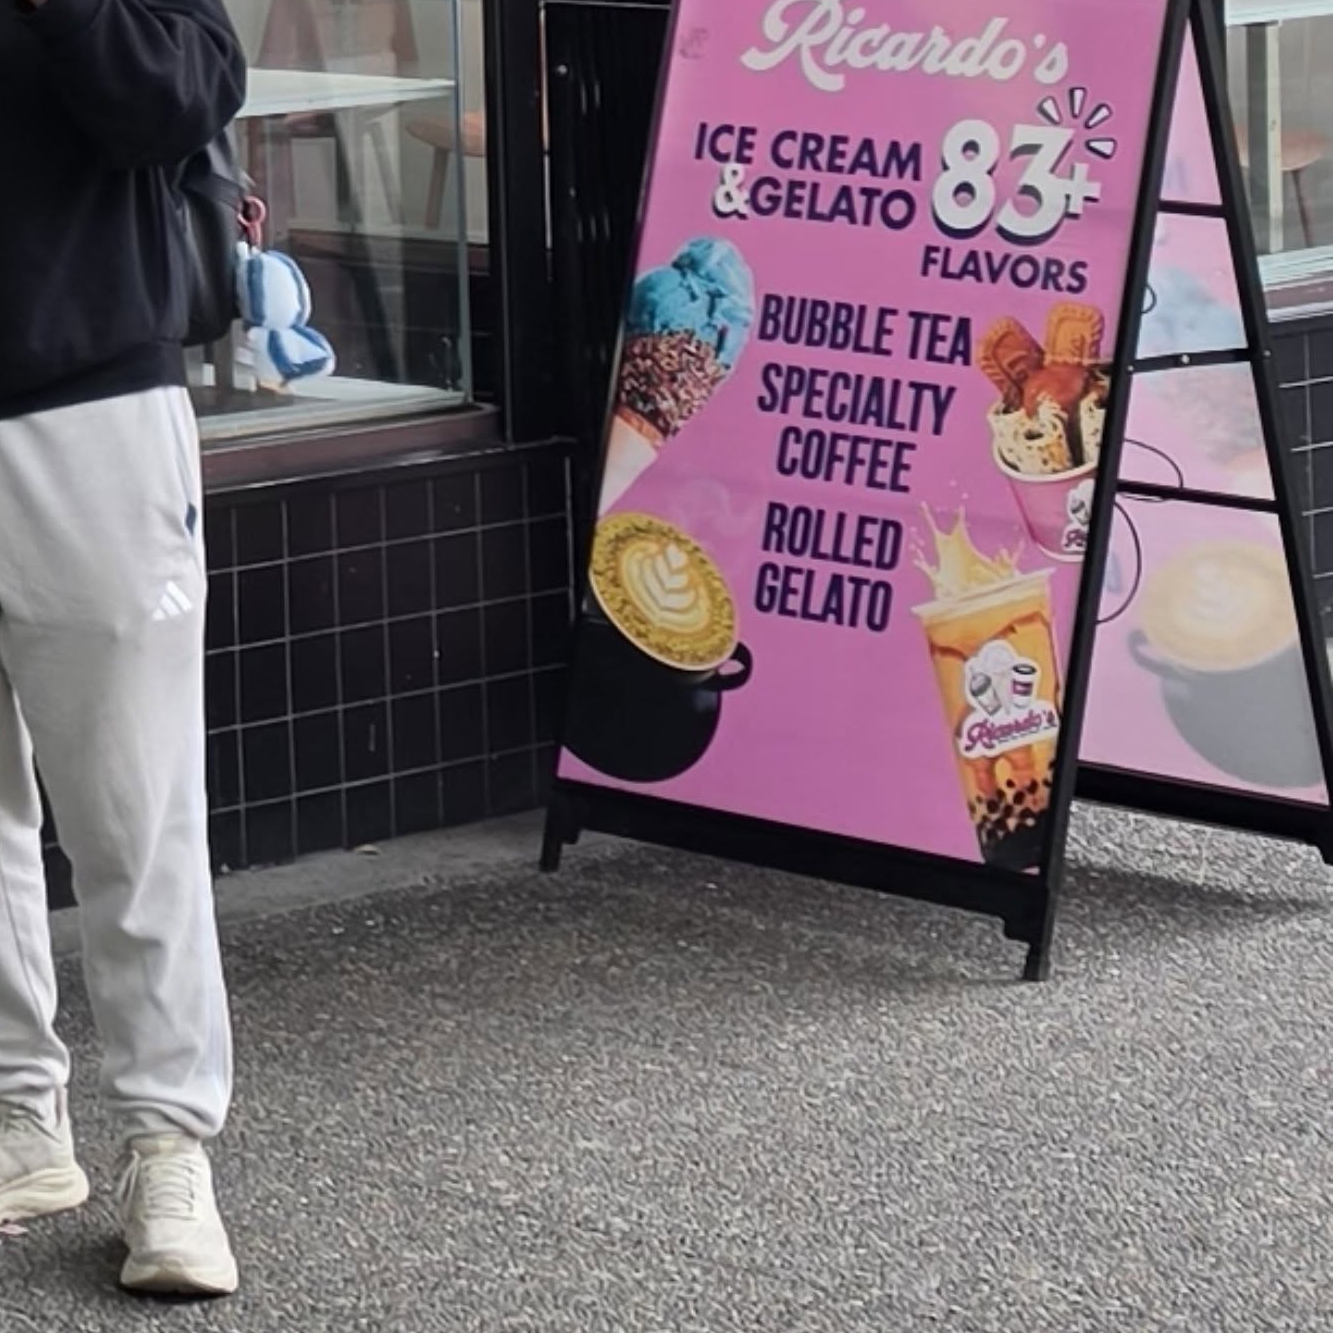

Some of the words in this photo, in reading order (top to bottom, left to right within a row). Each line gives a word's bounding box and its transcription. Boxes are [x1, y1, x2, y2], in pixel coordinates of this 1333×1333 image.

[694, 121, 757, 165] ICE
[769, 129, 923, 182] CREAM
[920, 244, 1090, 295] FLAVORS
[758, 292, 899, 357] BUBBLE
[907, 309, 973, 367] TEA
[756, 361, 958, 437] SPECIALTY
[776, 425, 918, 494] COFFEE
[761, 500, 904, 571] ROLLED
[753, 561, 894, 633] GELATO
